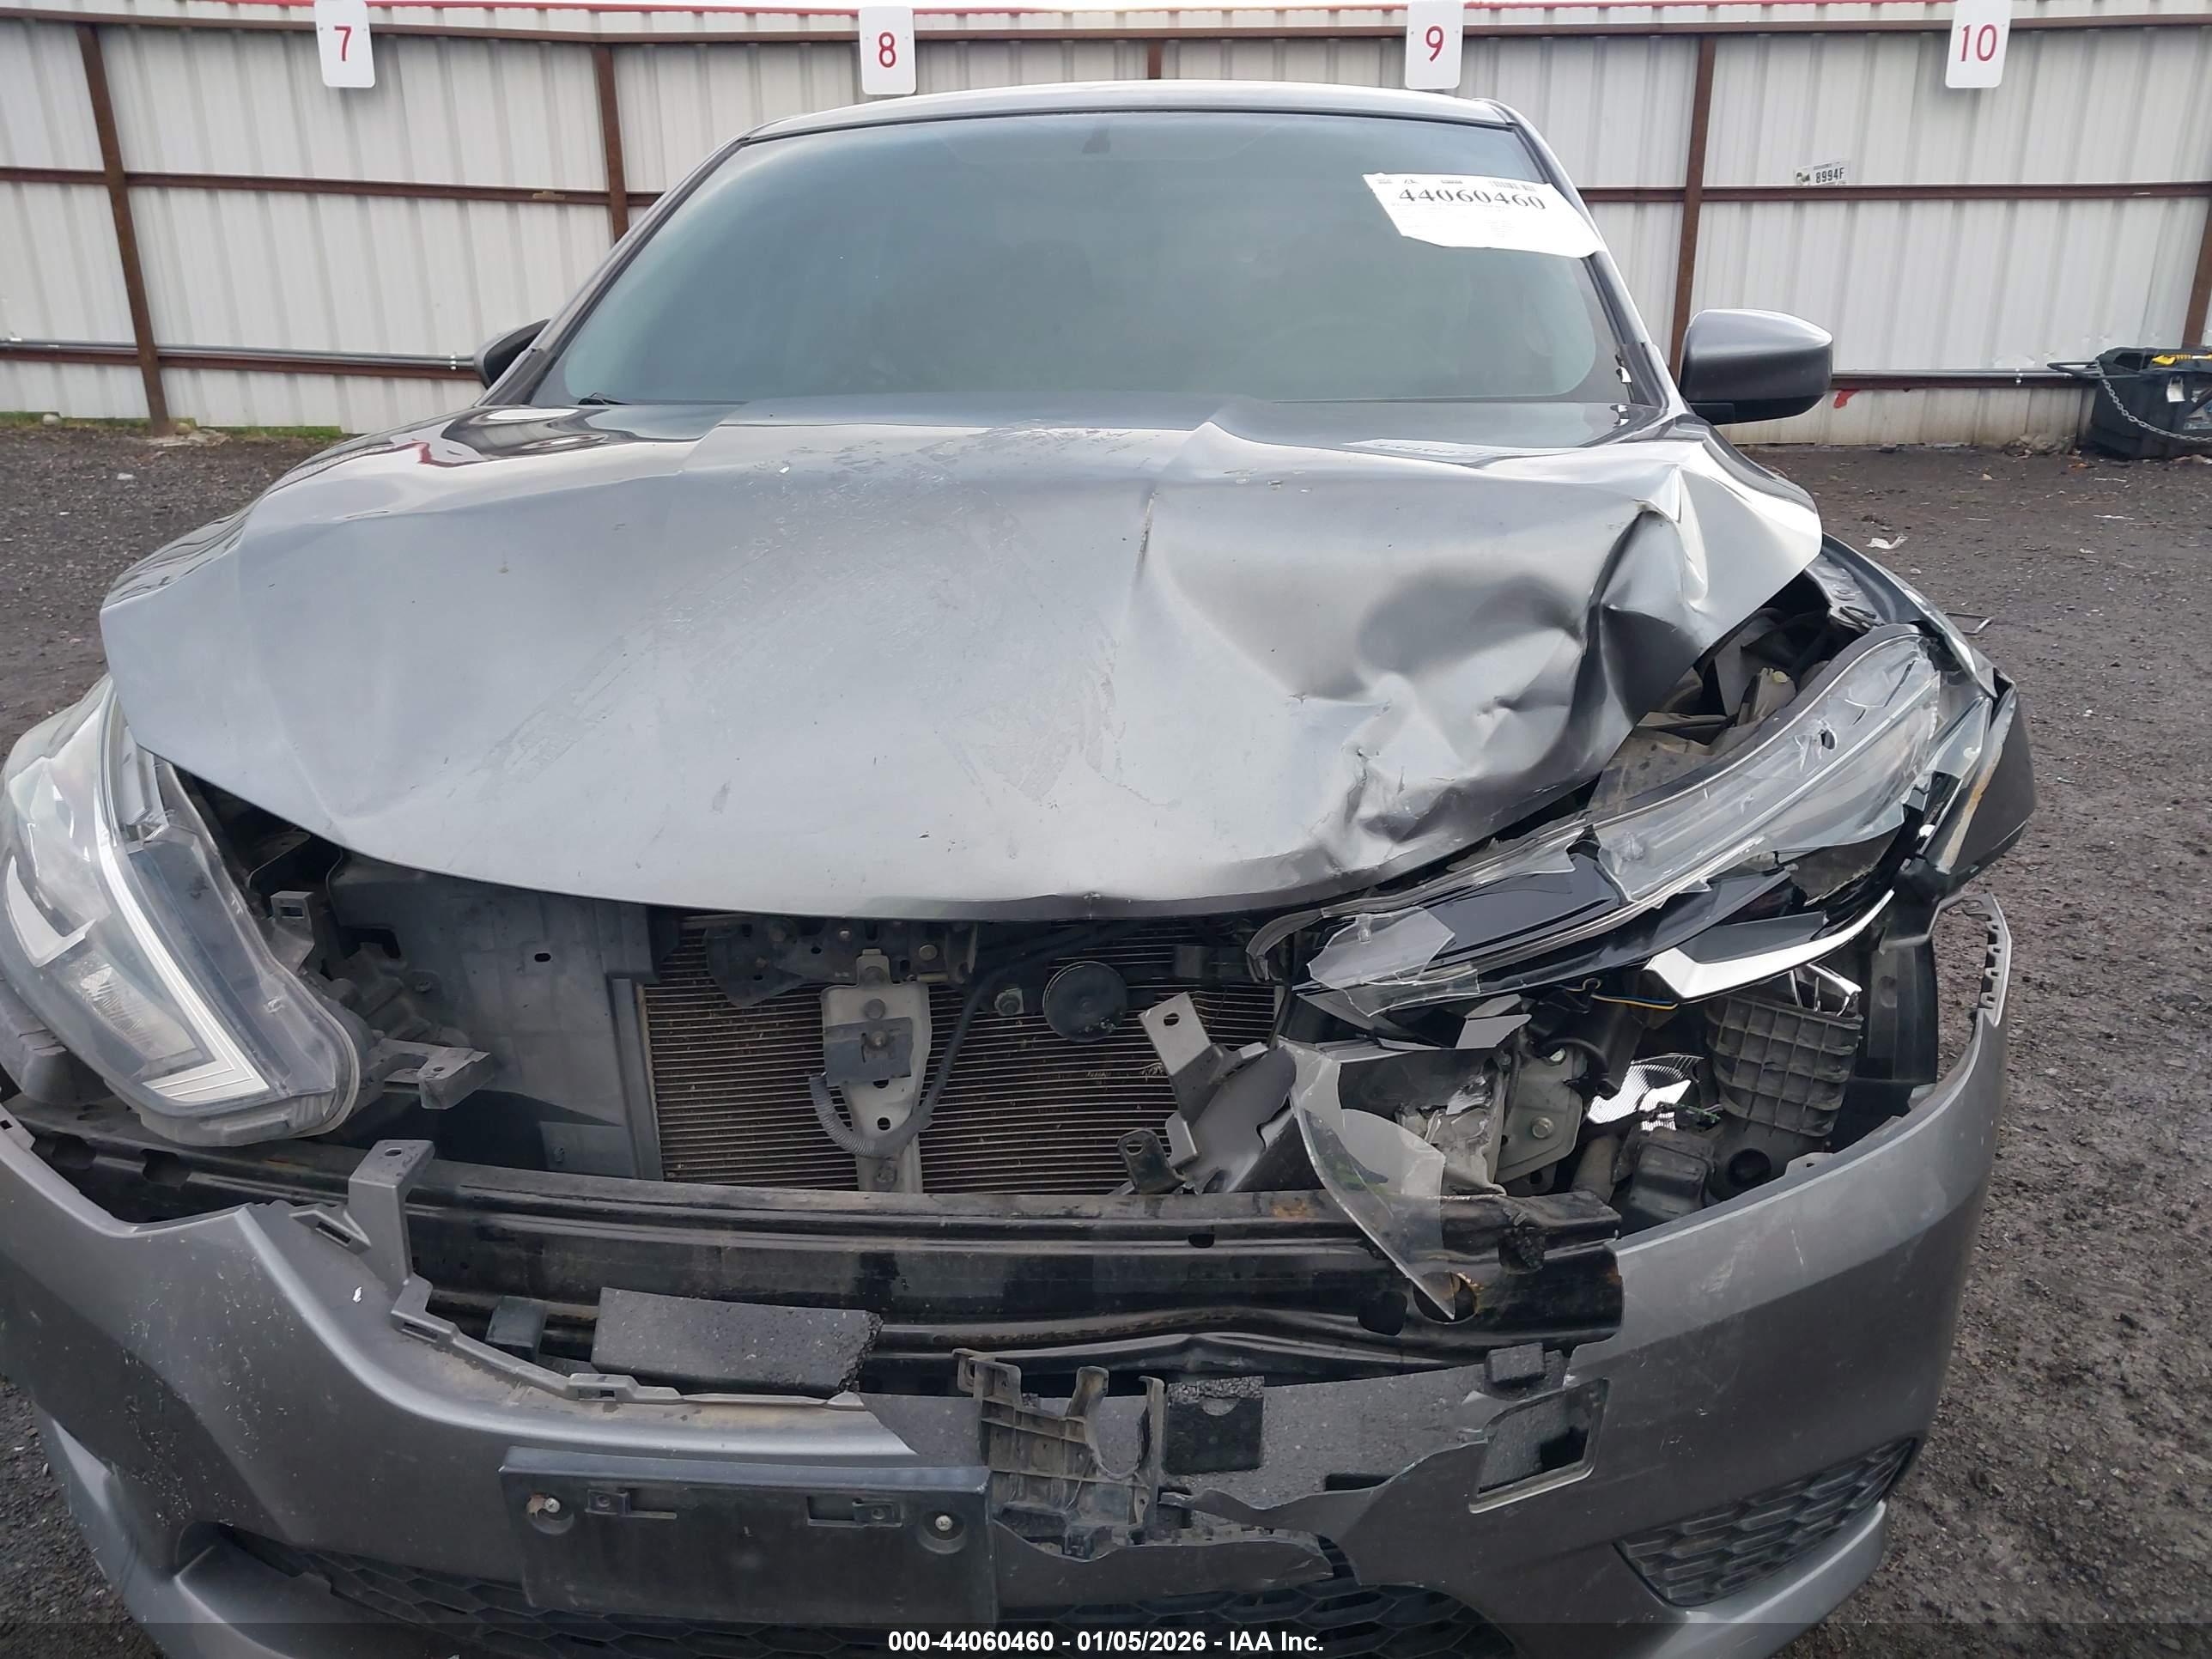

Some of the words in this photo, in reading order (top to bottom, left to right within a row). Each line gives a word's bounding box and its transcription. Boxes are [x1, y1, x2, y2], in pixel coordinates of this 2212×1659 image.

[334, 25, 353, 63] 7
[878, 31, 896, 69] 8
[1425, 25, 1444, 63] 9
[1959, 23, 1997, 63] 10
[1815, 167, 1844, 184] 8994F
[1399, 188, 1547, 210] 44060460
